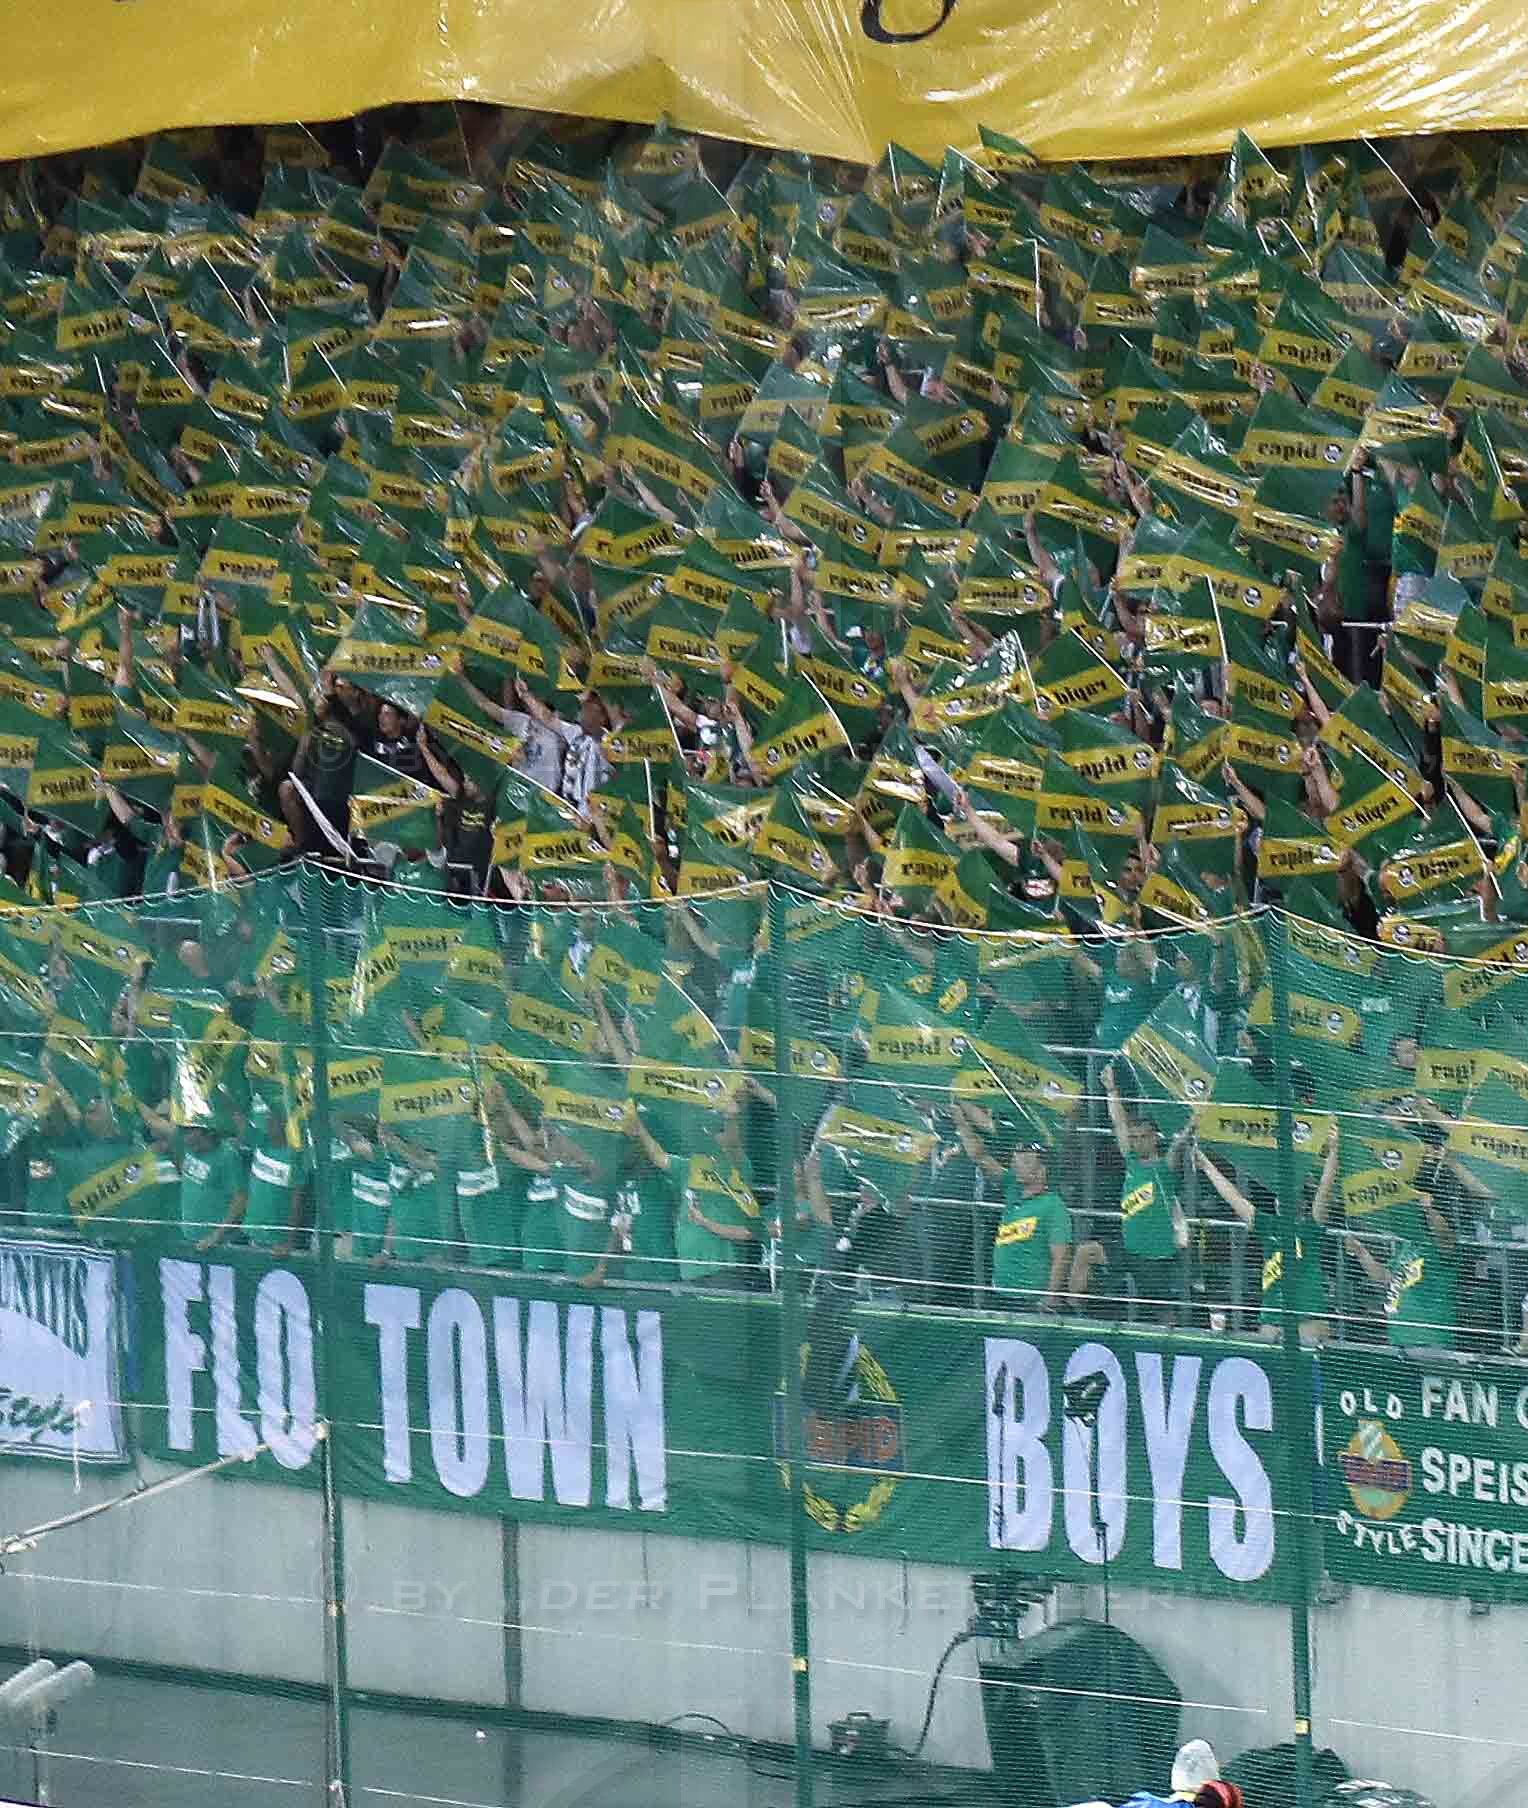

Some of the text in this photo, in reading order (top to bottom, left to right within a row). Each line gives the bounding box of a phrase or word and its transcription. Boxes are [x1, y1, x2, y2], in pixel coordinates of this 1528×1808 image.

[1256, 440, 1317, 461] rapid
[160, 1256, 315, 1469] FLO
[364, 1284, 665, 1512] TOWN
[984, 1337, 1274, 1581] BOYS
[1340, 1389, 1403, 1420] OLD
[1422, 1377, 1498, 1427] FAN
